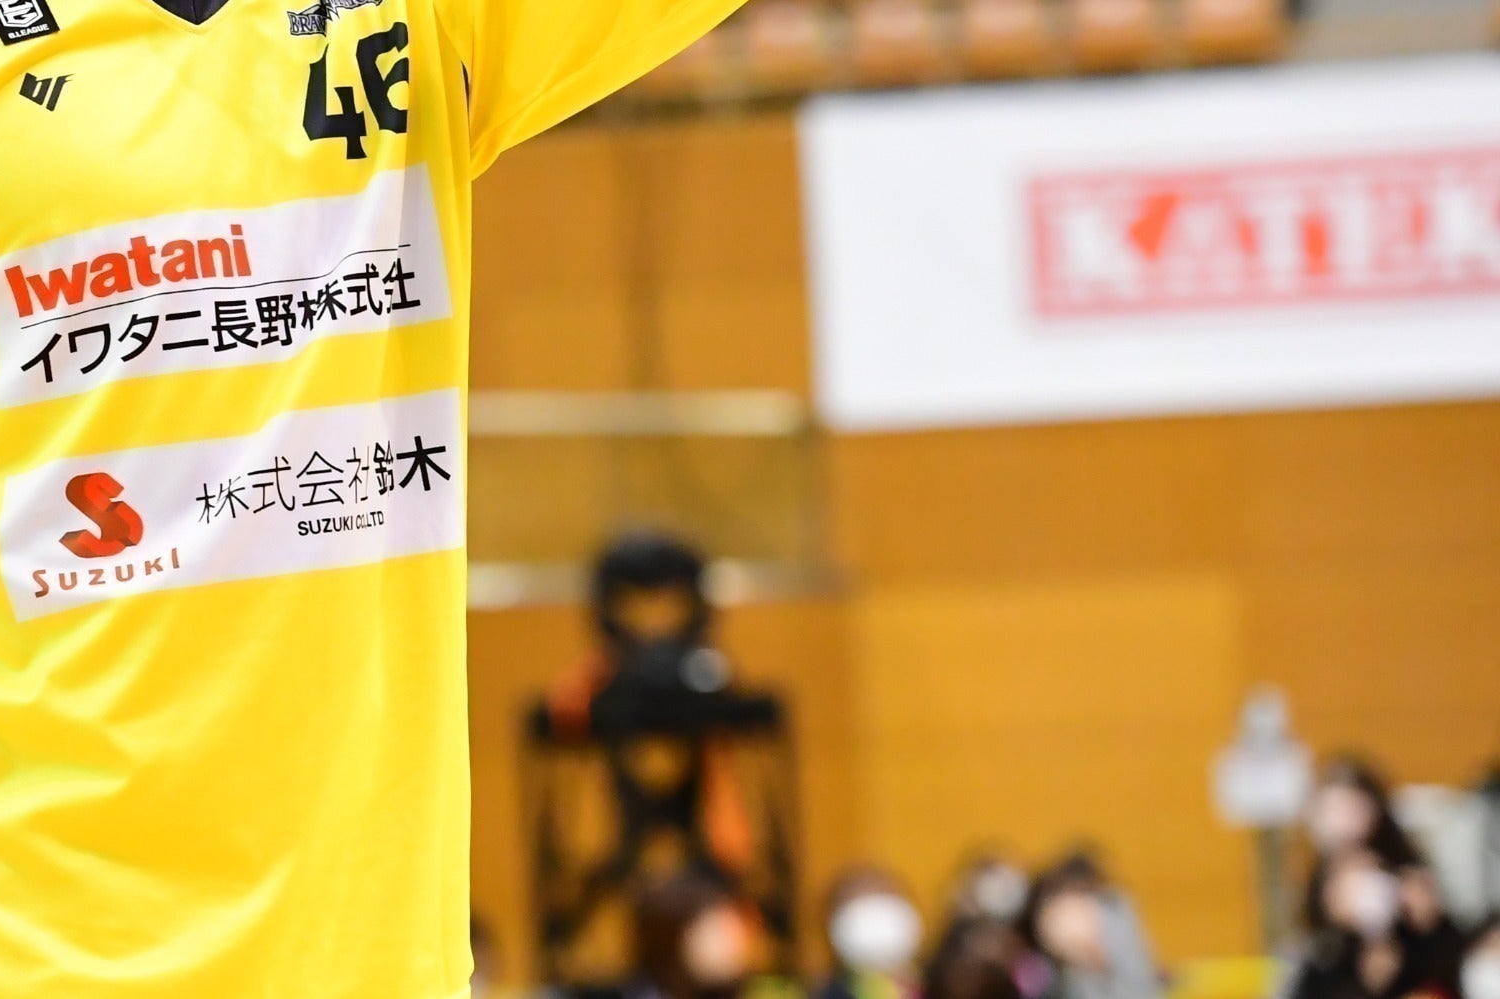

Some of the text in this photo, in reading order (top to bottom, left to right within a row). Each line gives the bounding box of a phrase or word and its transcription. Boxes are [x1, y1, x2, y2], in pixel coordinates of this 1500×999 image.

[302, 21, 408, 160] 46
[4, 224, 252, 318] Iwatani
[195, 435, 452, 525] 株式会社鈴木
[297, 515, 354, 537] SUZUKI
[31, 547, 181, 599] SUZUKI
